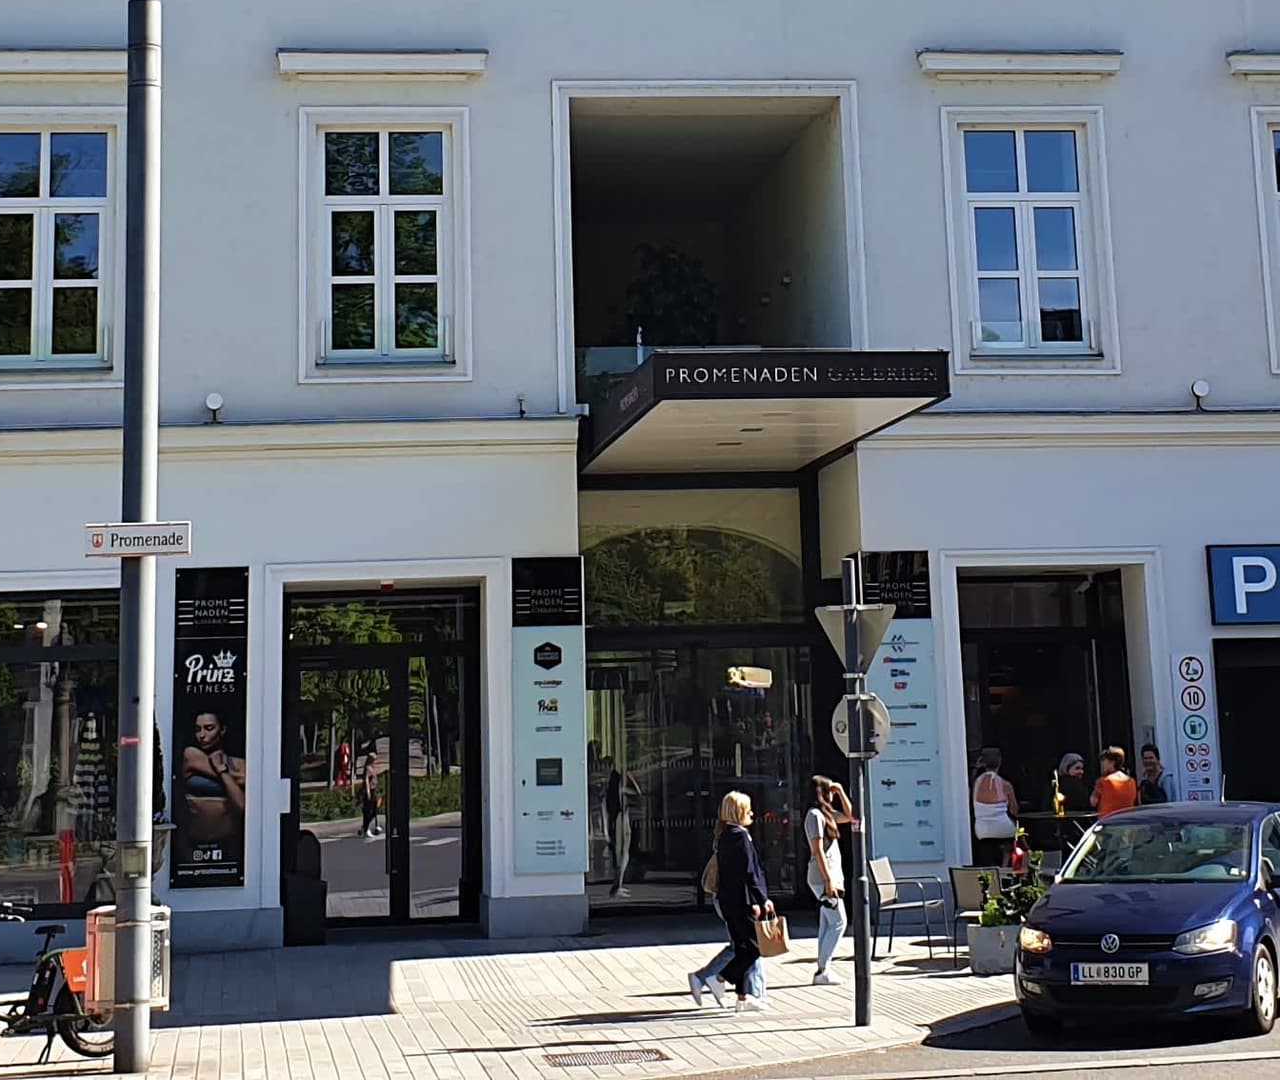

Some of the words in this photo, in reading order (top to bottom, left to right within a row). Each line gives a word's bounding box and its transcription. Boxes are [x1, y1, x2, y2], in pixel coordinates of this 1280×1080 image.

[665, 367, 818, 384] PROMENADEN
[827, 367, 938, 383] GALERIEN
[110, 531, 184, 548] Promenade
[1231, 555, 1278, 615] P
[194, 608, 229, 617] NADEN
[185, 653, 236, 684] Prinz
[186, 683, 236, 694] FITNESS
[1186, 690, 1200, 706] 10
[1103, 965, 1126, 979] 830
[1127, 965, 1143, 979] GP
